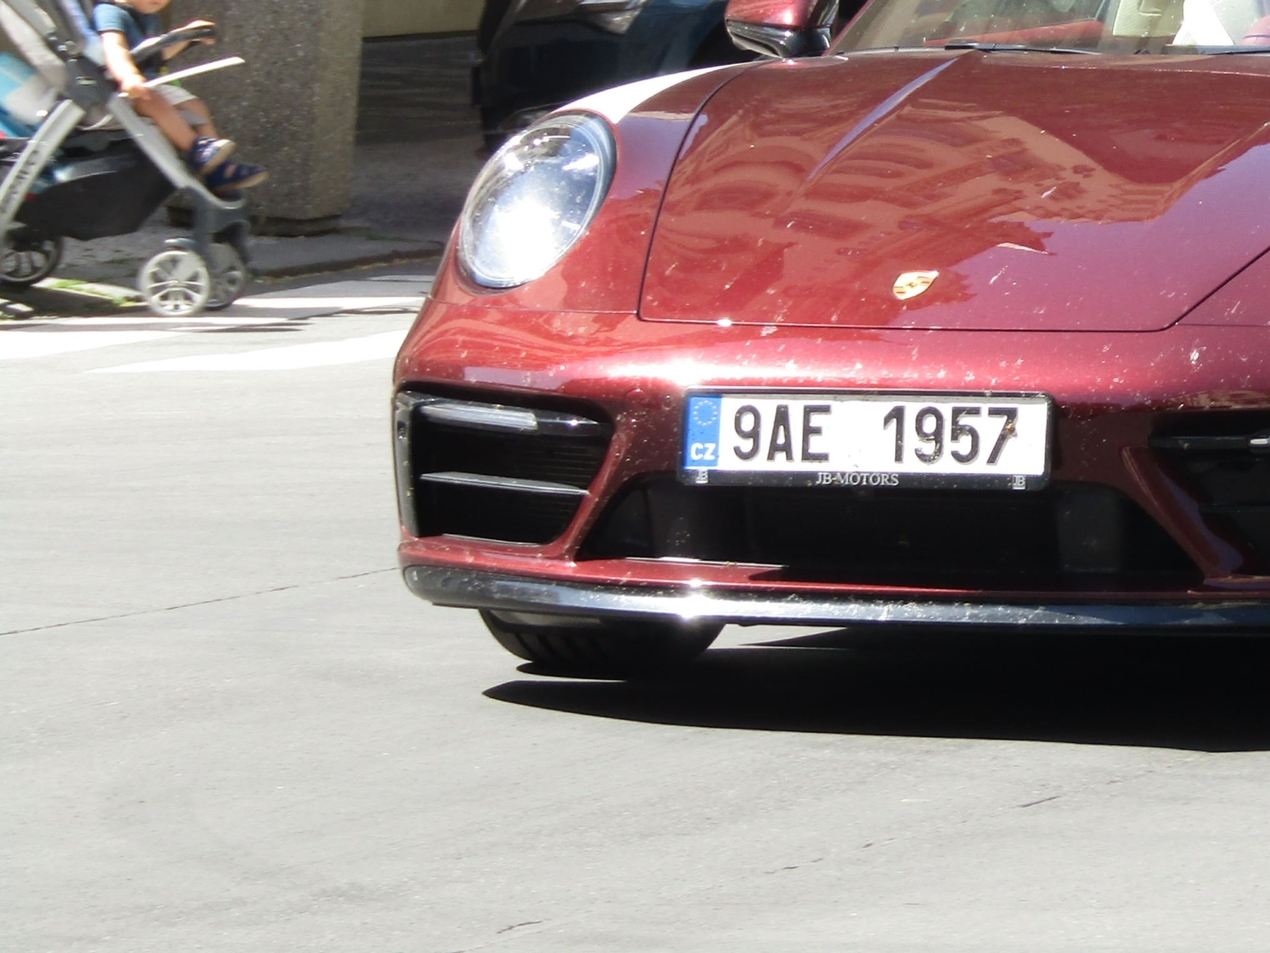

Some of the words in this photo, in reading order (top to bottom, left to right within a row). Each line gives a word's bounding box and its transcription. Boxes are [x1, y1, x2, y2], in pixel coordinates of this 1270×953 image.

[733, 404, 832, 464] 9AE
[883, 405, 1018, 465] 1957
[690, 443, 716, 461] CZ
[815, 472, 900, 486] JB-MOTORS
